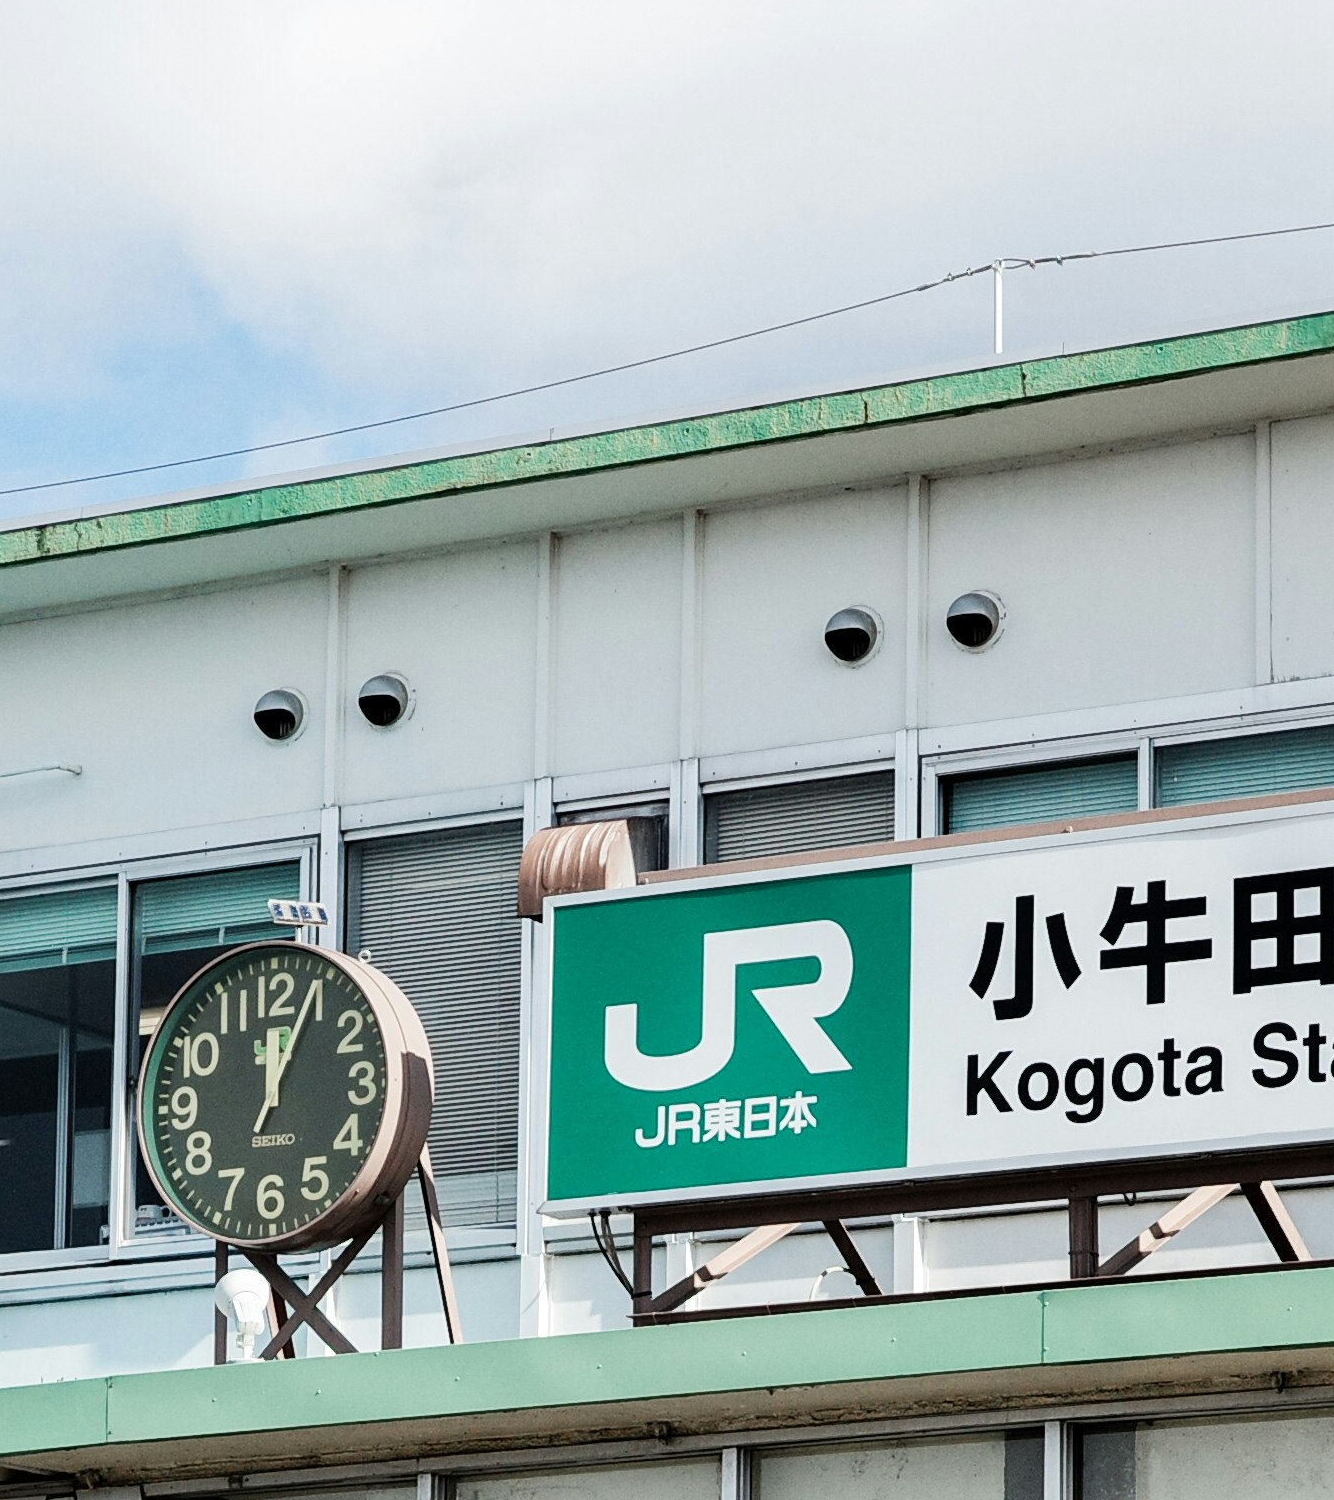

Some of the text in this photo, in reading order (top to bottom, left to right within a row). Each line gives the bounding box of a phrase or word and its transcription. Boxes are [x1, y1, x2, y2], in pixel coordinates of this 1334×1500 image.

[220, 989, 247, 1035] 11
[257, 972, 296, 1019] 12
[604, 919, 854, 1092] JR
[336, 1009, 364, 1054] 2
[183, 1032, 219, 1078] 10
[347, 1060, 377, 1107] 3
[966, 1037, 1224, 1124] Kogota
[171, 1086, 199, 1131] 9
[634, 1090, 818, 1148] JR東日本
[185, 1130, 213, 1176] 8
[251, 1133, 296, 1148] SEIKO
[332, 1113, 364, 1157] 4
[217, 1167, 246, 1212] 7
[256, 1174, 285, 1220] 6
[300, 1156, 330, 1201] 5
